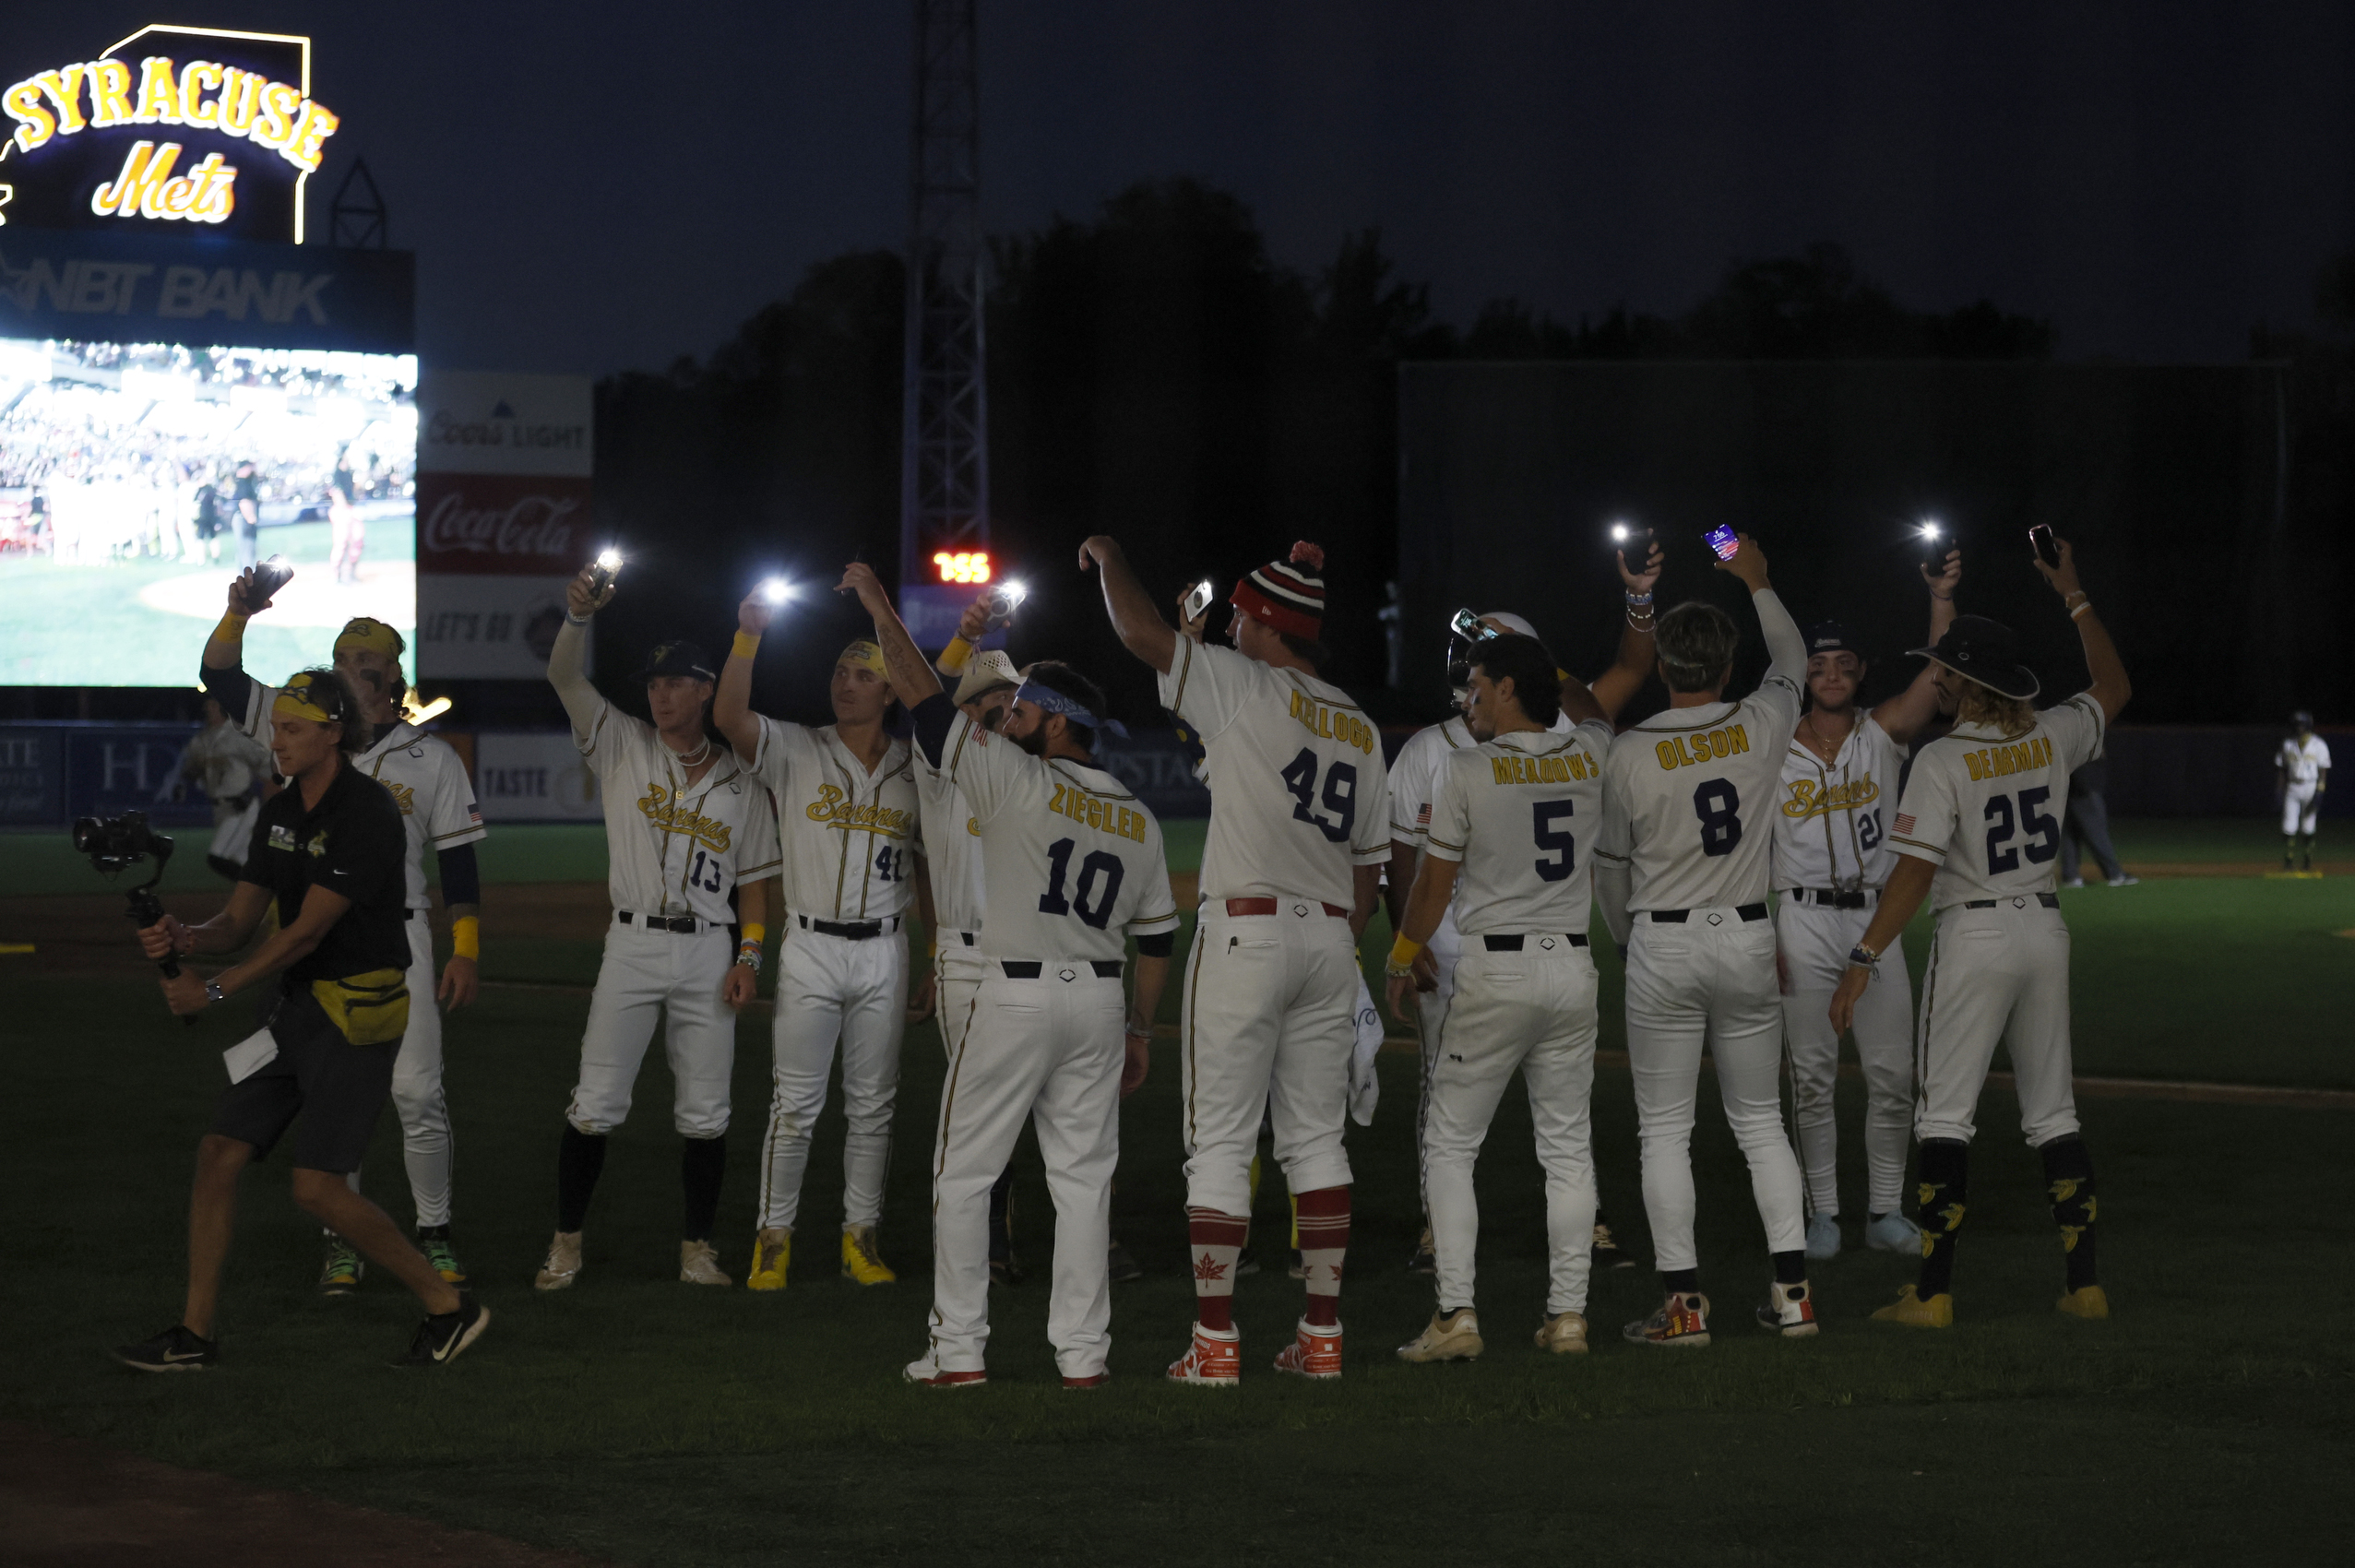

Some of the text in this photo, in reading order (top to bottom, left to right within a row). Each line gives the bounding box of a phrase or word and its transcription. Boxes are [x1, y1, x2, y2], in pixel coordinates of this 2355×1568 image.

[2, 55, 339, 173] SYRACUSE
[91, 139, 238, 223] Mets
[28, 258, 336, 325] NBT BANK
[1290, 689, 1374, 755] KELLOGG
[1656, 724, 1750, 771] OLSON
[485, 767, 547, 798] TASTE
[1280, 746, 1357, 843] 49
[1491, 750, 1600, 785] MEADOWS
[637, 782, 731, 846] Bananas
[806, 783, 912, 834] Bananas
[1049, 782, 1147, 844] ZIEGLER
[1532, 799, 1575, 882] 5
[1694, 778, 1742, 857] 8
[1984, 786, 2060, 875] 25
[690, 850, 721, 894] 13
[875, 845, 903, 882] 41
[1039, 837, 1124, 930] 10
